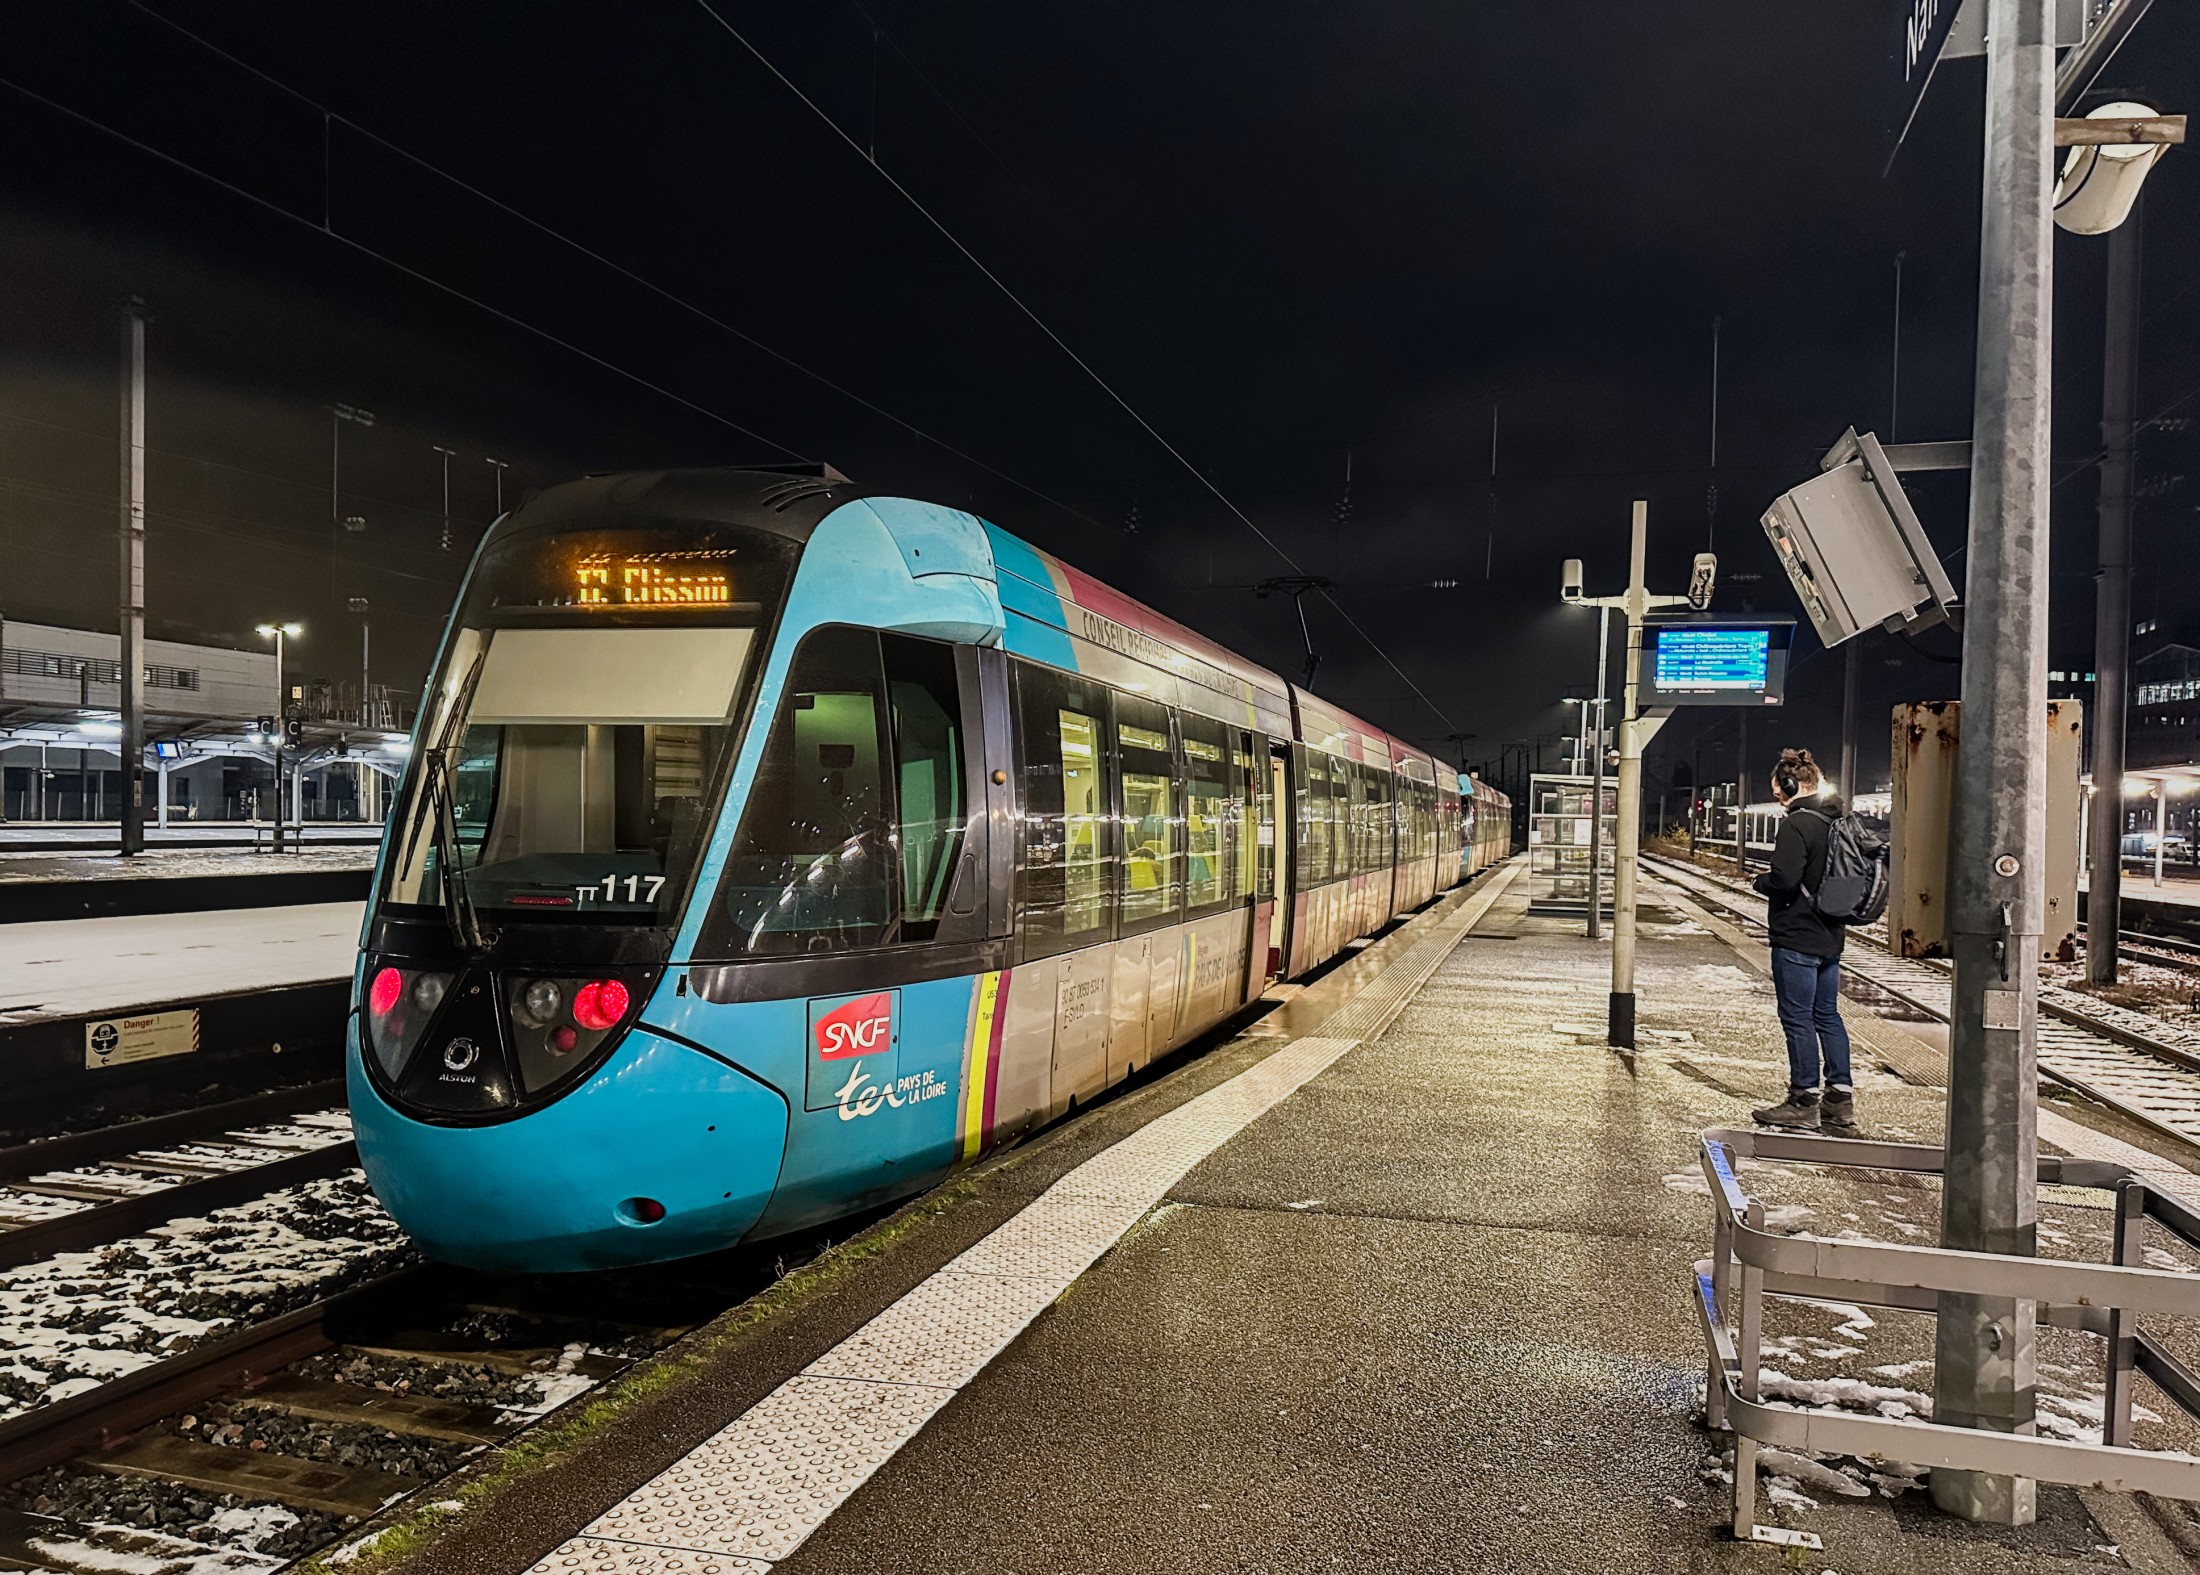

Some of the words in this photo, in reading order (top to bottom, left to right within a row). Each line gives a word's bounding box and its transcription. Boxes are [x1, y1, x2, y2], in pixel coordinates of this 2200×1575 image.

[1083, 611, 1127, 652] CONSEIL
[260, 721, 271, 735] C
[288, 721, 298, 735] C
[124, 1018, 154, 1029] Danger
[821, 1016, 890, 1053] SNCF
[834, 1059, 907, 1121] ter
[897, 1073, 922, 1093] PAYS
[922, 1069, 935, 1086] DE
[908, 1088, 920, 1105] LA
[921, 1080, 947, 1101] LOIRE
